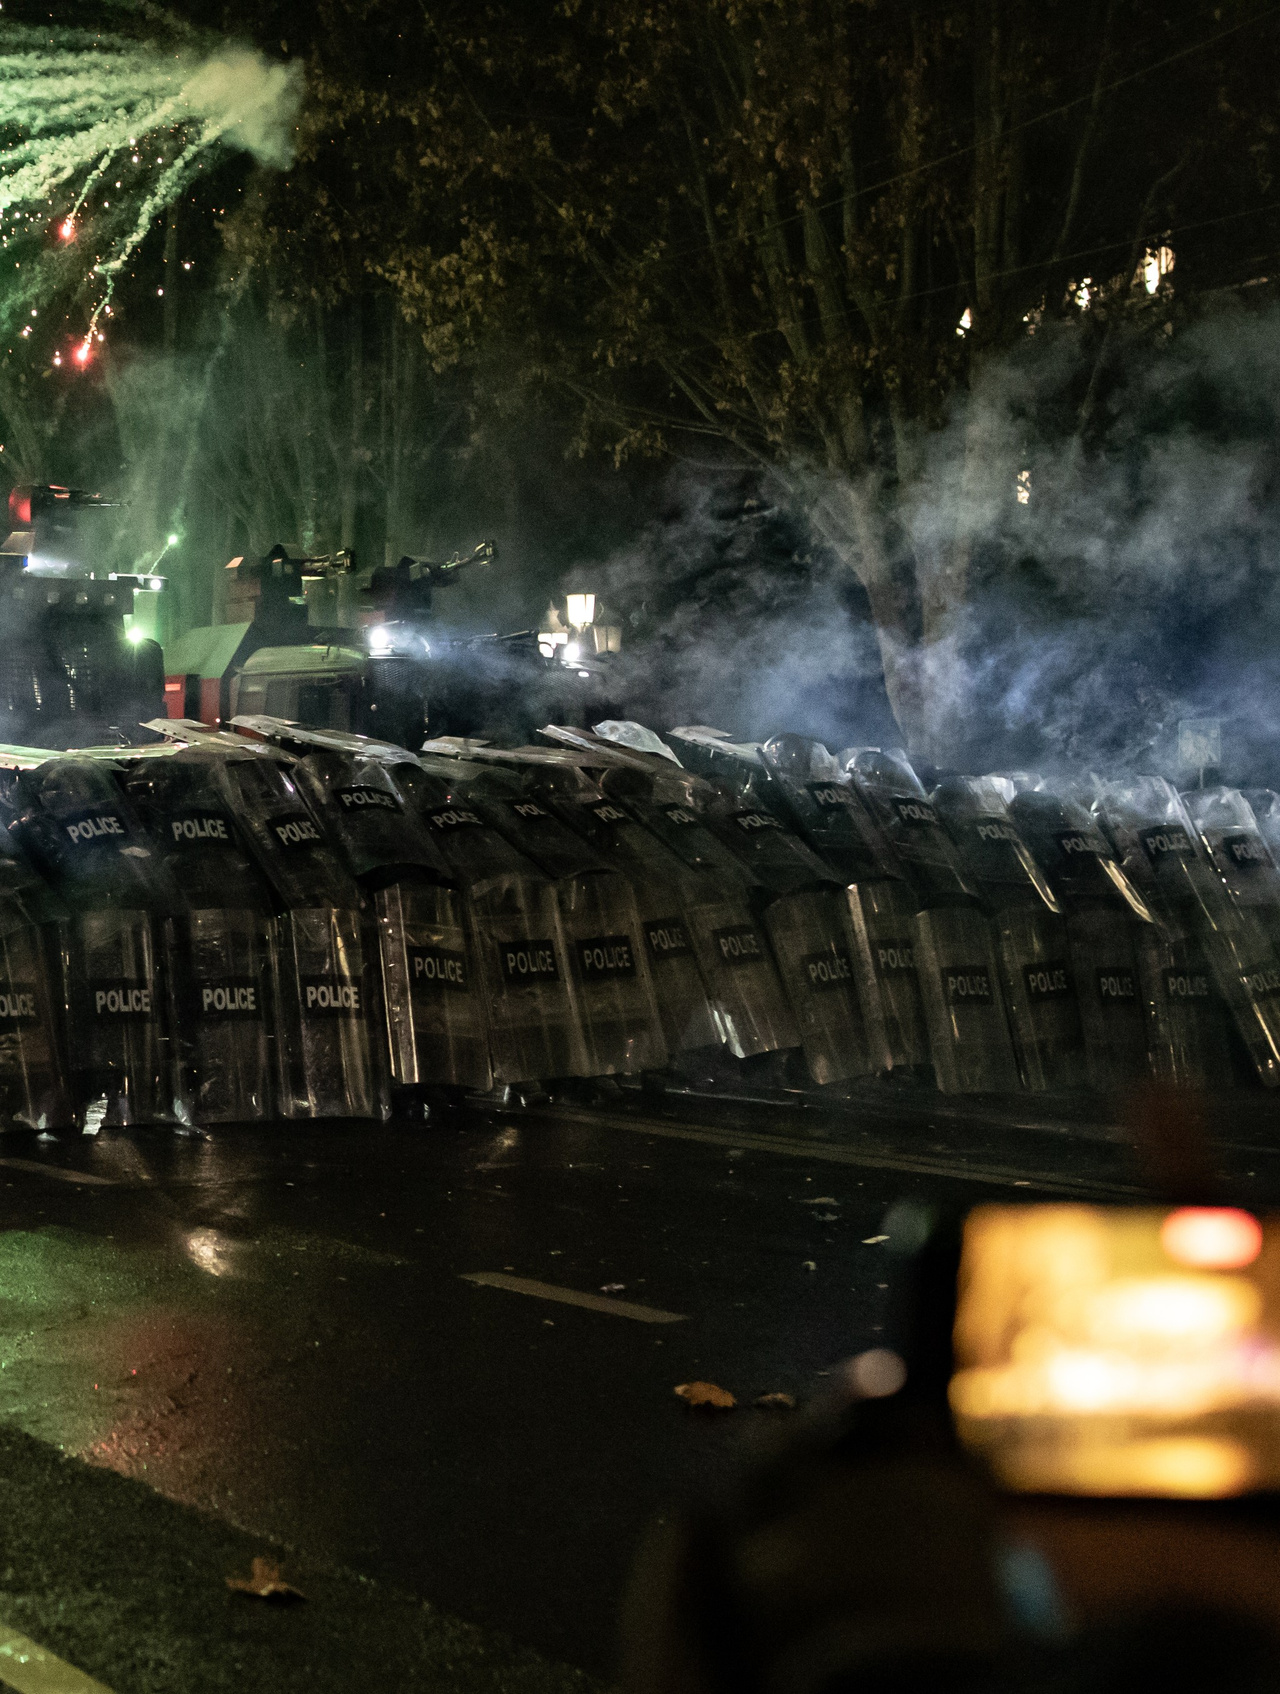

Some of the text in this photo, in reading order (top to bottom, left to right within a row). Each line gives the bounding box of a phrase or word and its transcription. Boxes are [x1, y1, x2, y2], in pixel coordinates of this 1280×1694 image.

[341, 791, 396, 808] POLICE
[67, 816, 125, 844] POLICE
[172, 817, 229, 841] POLICE
[414, 956, 464, 984] POLICE
[507, 949, 555, 975] POLICE
[584, 945, 631, 972] POLICE
[96, 988, 151, 1015] POLICE
[202, 987, 257, 1011] POLICE
[307, 985, 360, 1009] POLICE
